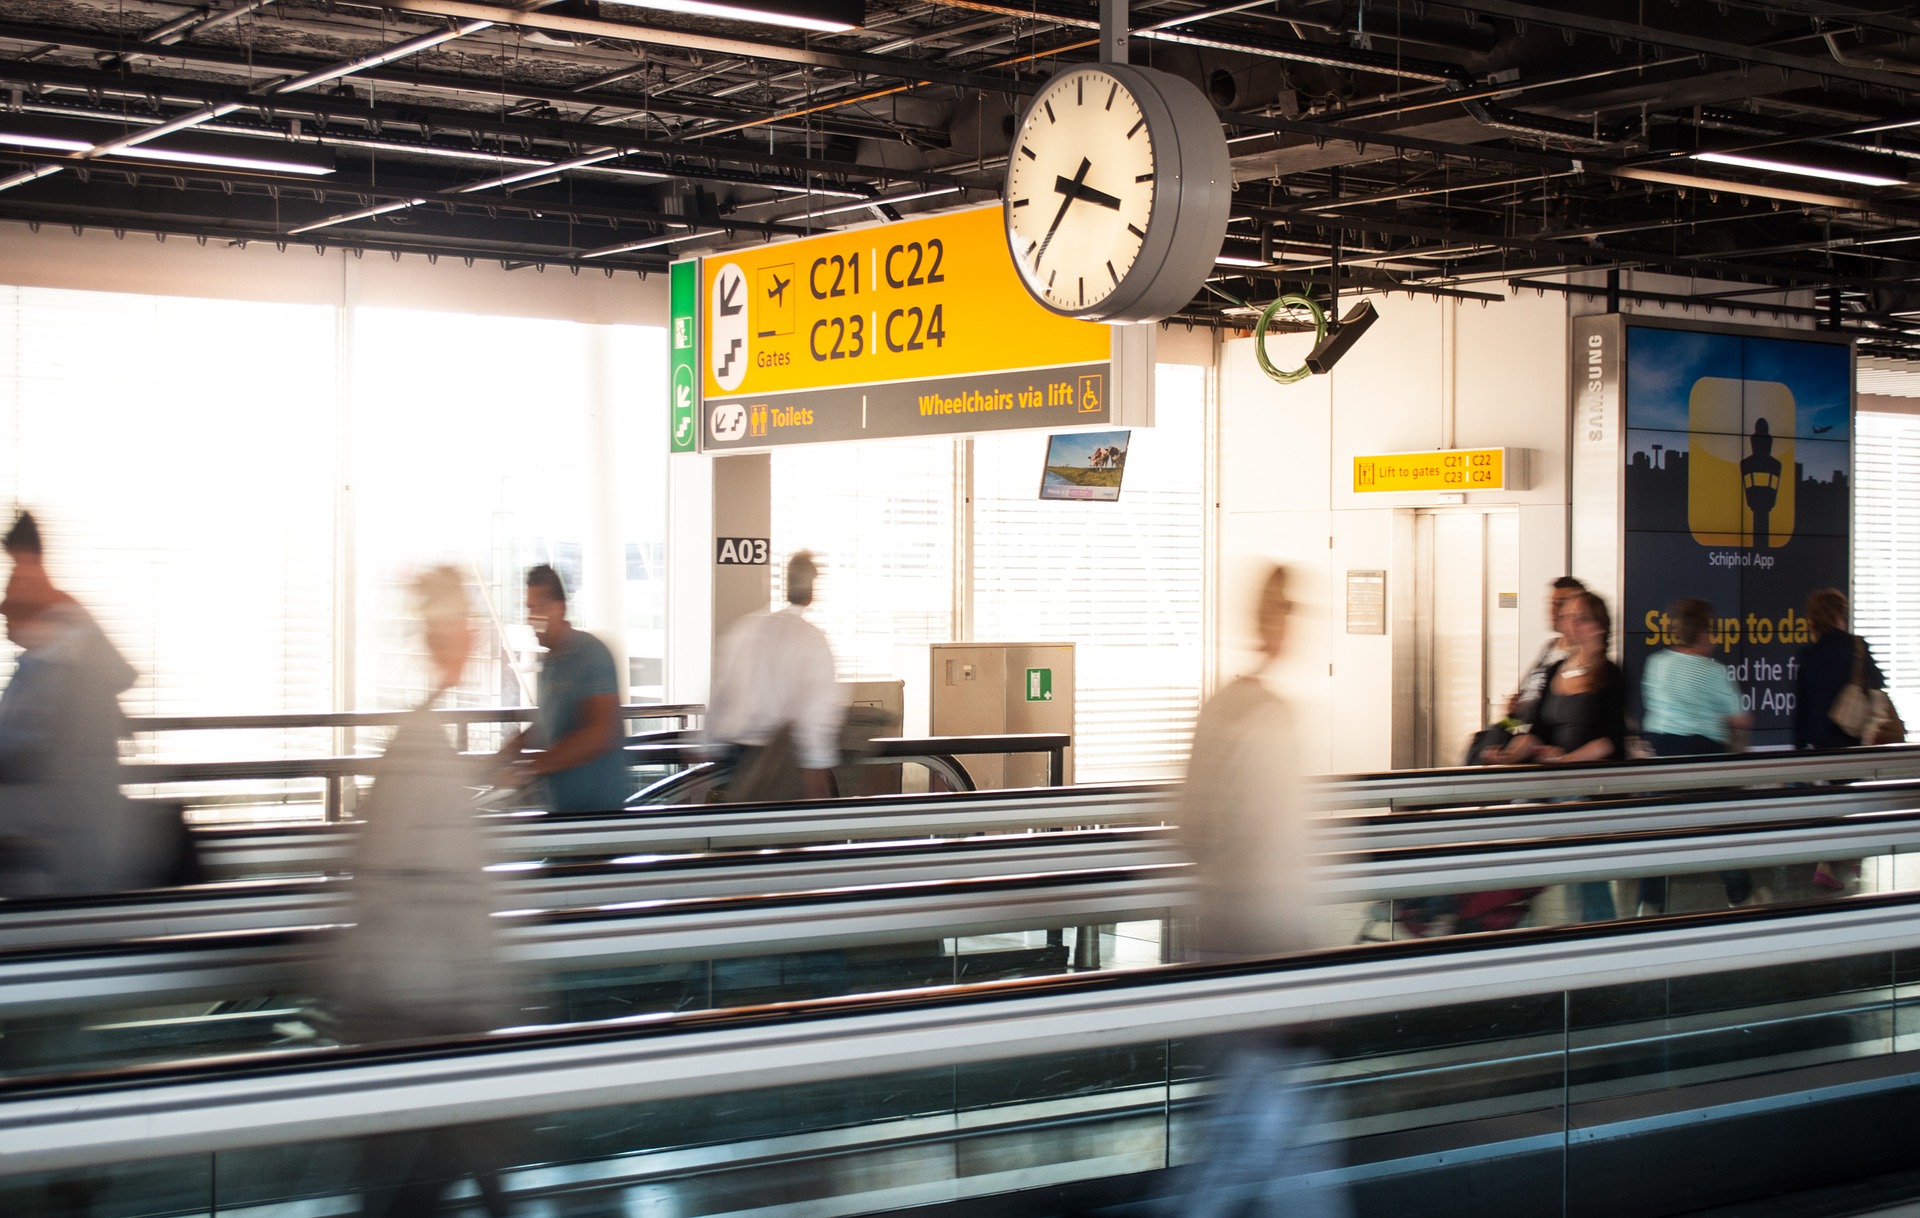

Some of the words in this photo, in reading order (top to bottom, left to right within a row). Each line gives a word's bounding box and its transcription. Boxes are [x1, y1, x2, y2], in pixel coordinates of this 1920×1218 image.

[809, 251, 860, 301] C21
[884, 237, 945, 290] C22
[809, 313, 865, 363] C23
[884, 303, 947, 354] C24
[756, 350, 791, 368] Gates
[918, 388, 1013, 416] Wheelchairs
[1018, 386, 1043, 407] via
[1047, 383, 1073, 406] lift
[1588, 334, 1603, 442] SAMSUNG
[770, 404, 814, 428] Toilets
[1379, 467, 1396, 478] Lift
[1399, 467, 1410, 478] to
[1412, 466, 1440, 480] gates
[1444, 456, 1462, 467] C21
[1472, 455, 1491, 466] C22
[1444, 472, 1462, 483] C23
[1472, 471, 1491, 482] C24
[718, 539, 768, 563] A03
[1708, 551, 1751, 569] Schiphol
[1753, 553, 1775, 570] App
[1707, 616, 1741, 653] up
[1745, 612, 1774, 645] to
[1753, 656, 1783, 682] the
[1760, 686, 1797, 716] App
